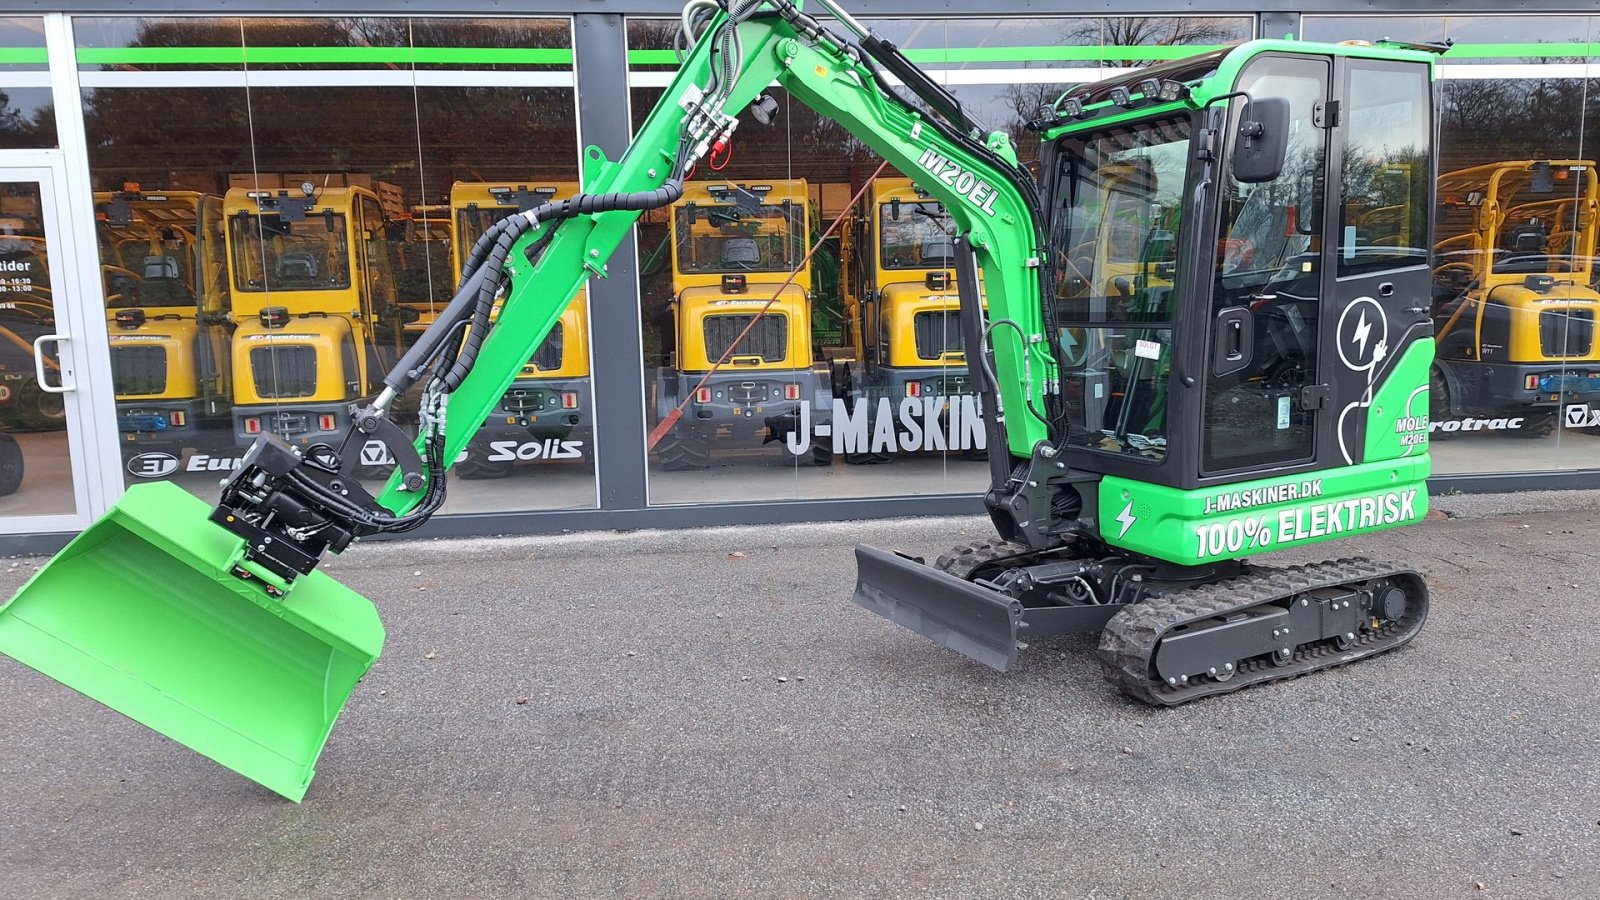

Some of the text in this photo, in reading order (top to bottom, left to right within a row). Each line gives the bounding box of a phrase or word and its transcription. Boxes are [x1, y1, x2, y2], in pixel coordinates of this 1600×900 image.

[917, 147, 1000, 217] M20EL
[0, 260, 31, 271] tider
[786, 395, 987, 455] J-MASKIN
[1395, 415, 1428, 433] MOLE
[1428, 417, 1524, 433] rotrac
[1400, 433, 1428, 446] M20EL
[1204, 479, 1323, 514] J-MASKINER.DK
[1196, 489, 1417, 558] 100% ELEKTRISK
